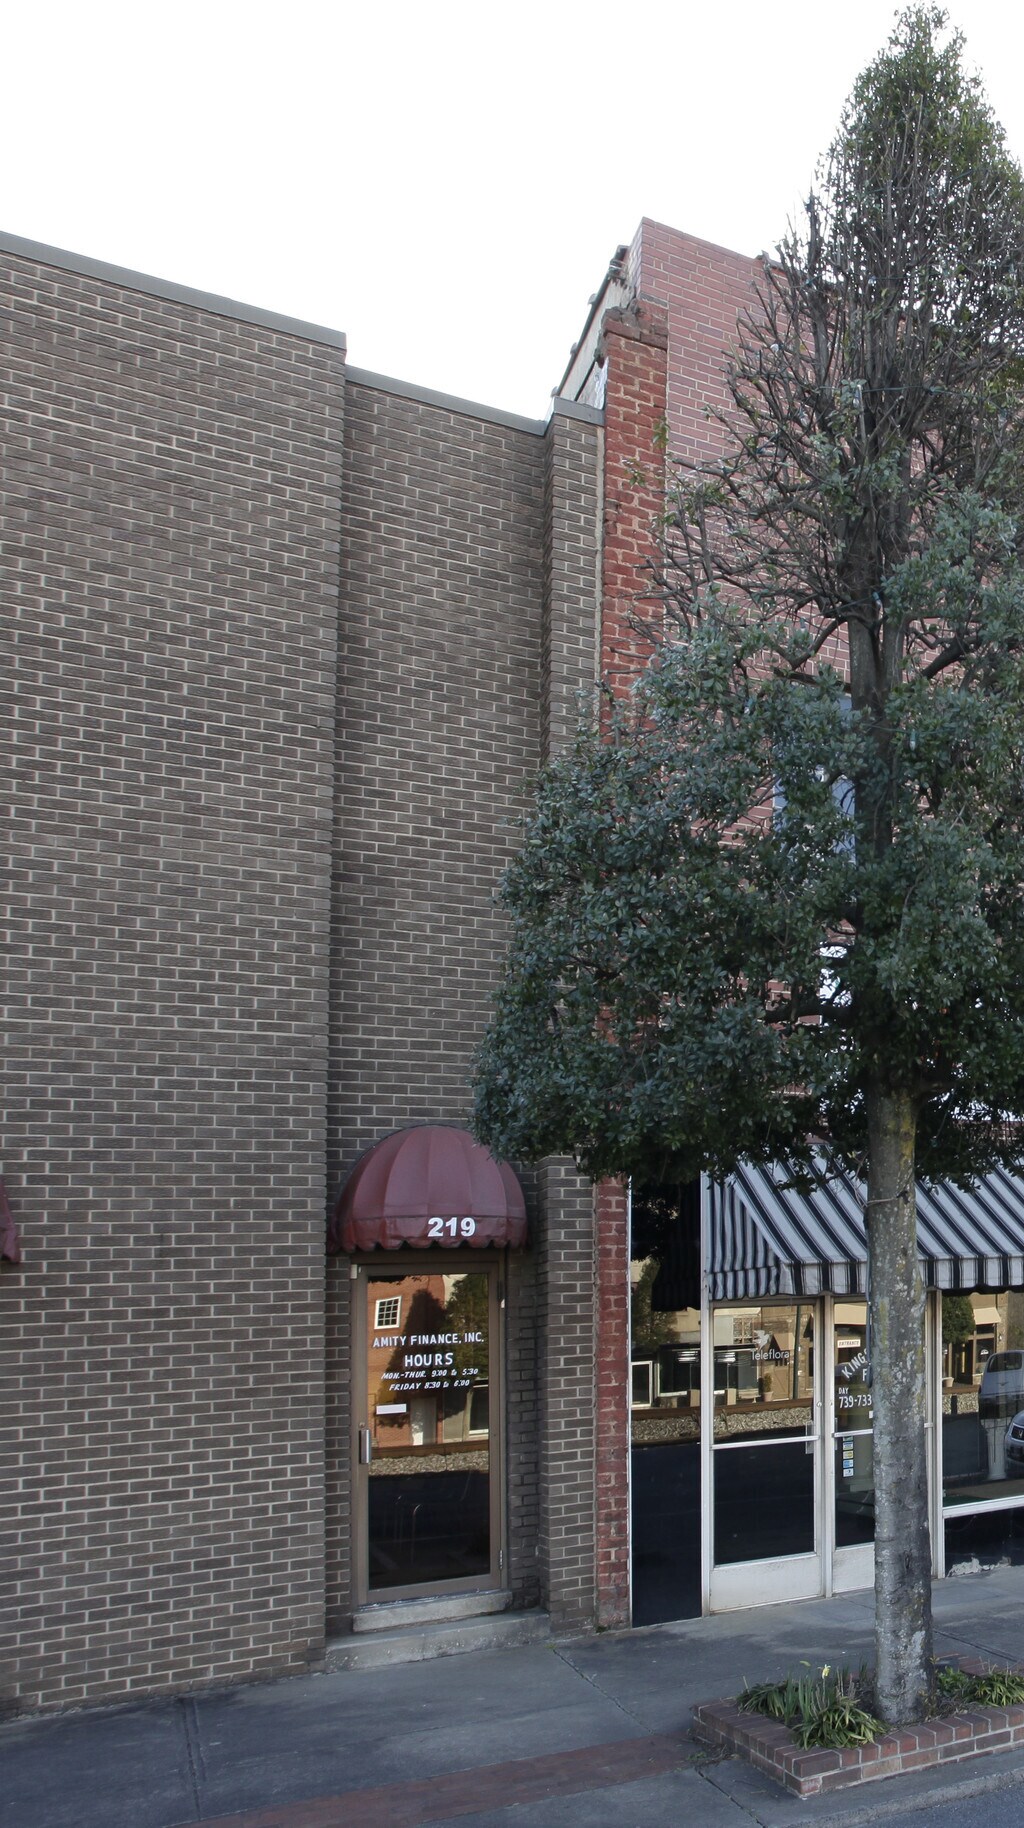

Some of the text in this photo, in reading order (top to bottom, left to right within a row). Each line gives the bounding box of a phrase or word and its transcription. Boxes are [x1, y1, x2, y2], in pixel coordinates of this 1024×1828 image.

[427, 1217, 475, 1237] 219
[373, 1332, 484, 1348] AMITY FINANCE, INC.
[404, 1352, 454, 1367] HOURS
[752, 1349, 789, 1360] Teleflora
[389, 1382, 421, 1391] FRIDAY
[838, 1394, 872, 1409] 739-733
